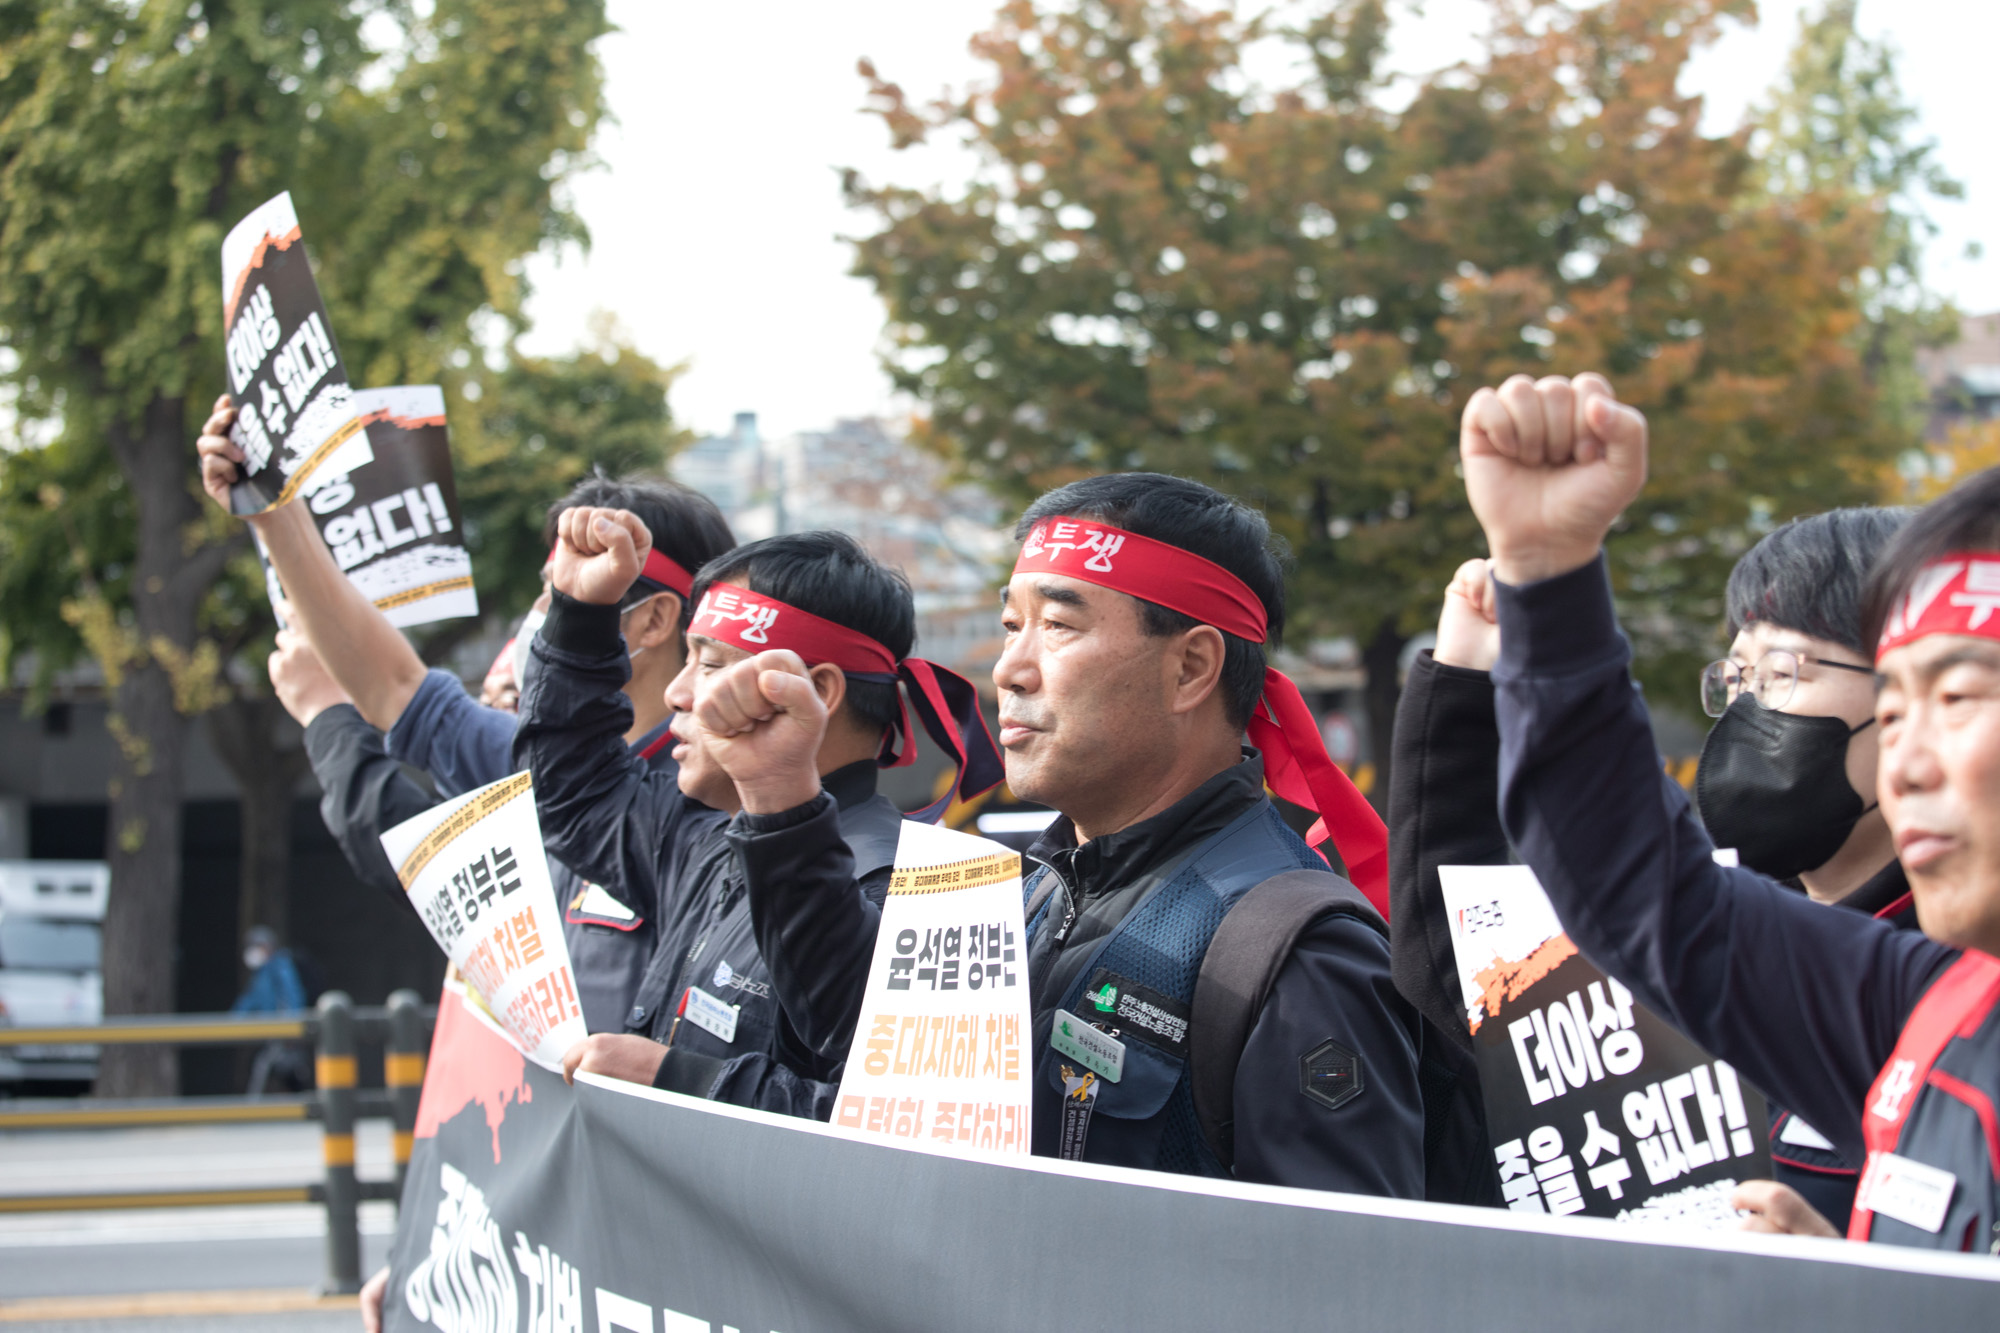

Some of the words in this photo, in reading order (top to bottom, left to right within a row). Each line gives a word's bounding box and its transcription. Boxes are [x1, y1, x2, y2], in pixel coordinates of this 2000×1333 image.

[226, 283, 281, 394] 더이상
[273, 311, 337, 413] 없다!
[259, 379, 288, 434] 수
[324, 482, 453, 571] 없다!
[1044, 522, 1125, 572] 투쟁
[707, 592, 779, 644] 투쟁
[452, 846, 522, 923] 정부는
[493, 905, 545, 976] 처벌
[887, 927, 962, 990] 윤석열
[864, 1014, 979, 1078] 중대재해
[983, 1013, 1019, 1080] 처벌
[1508, 976, 1643, 1106] 더이상
[1580, 1110, 1632, 1200] 수
[1621, 1059, 1755, 1185] 없다!
